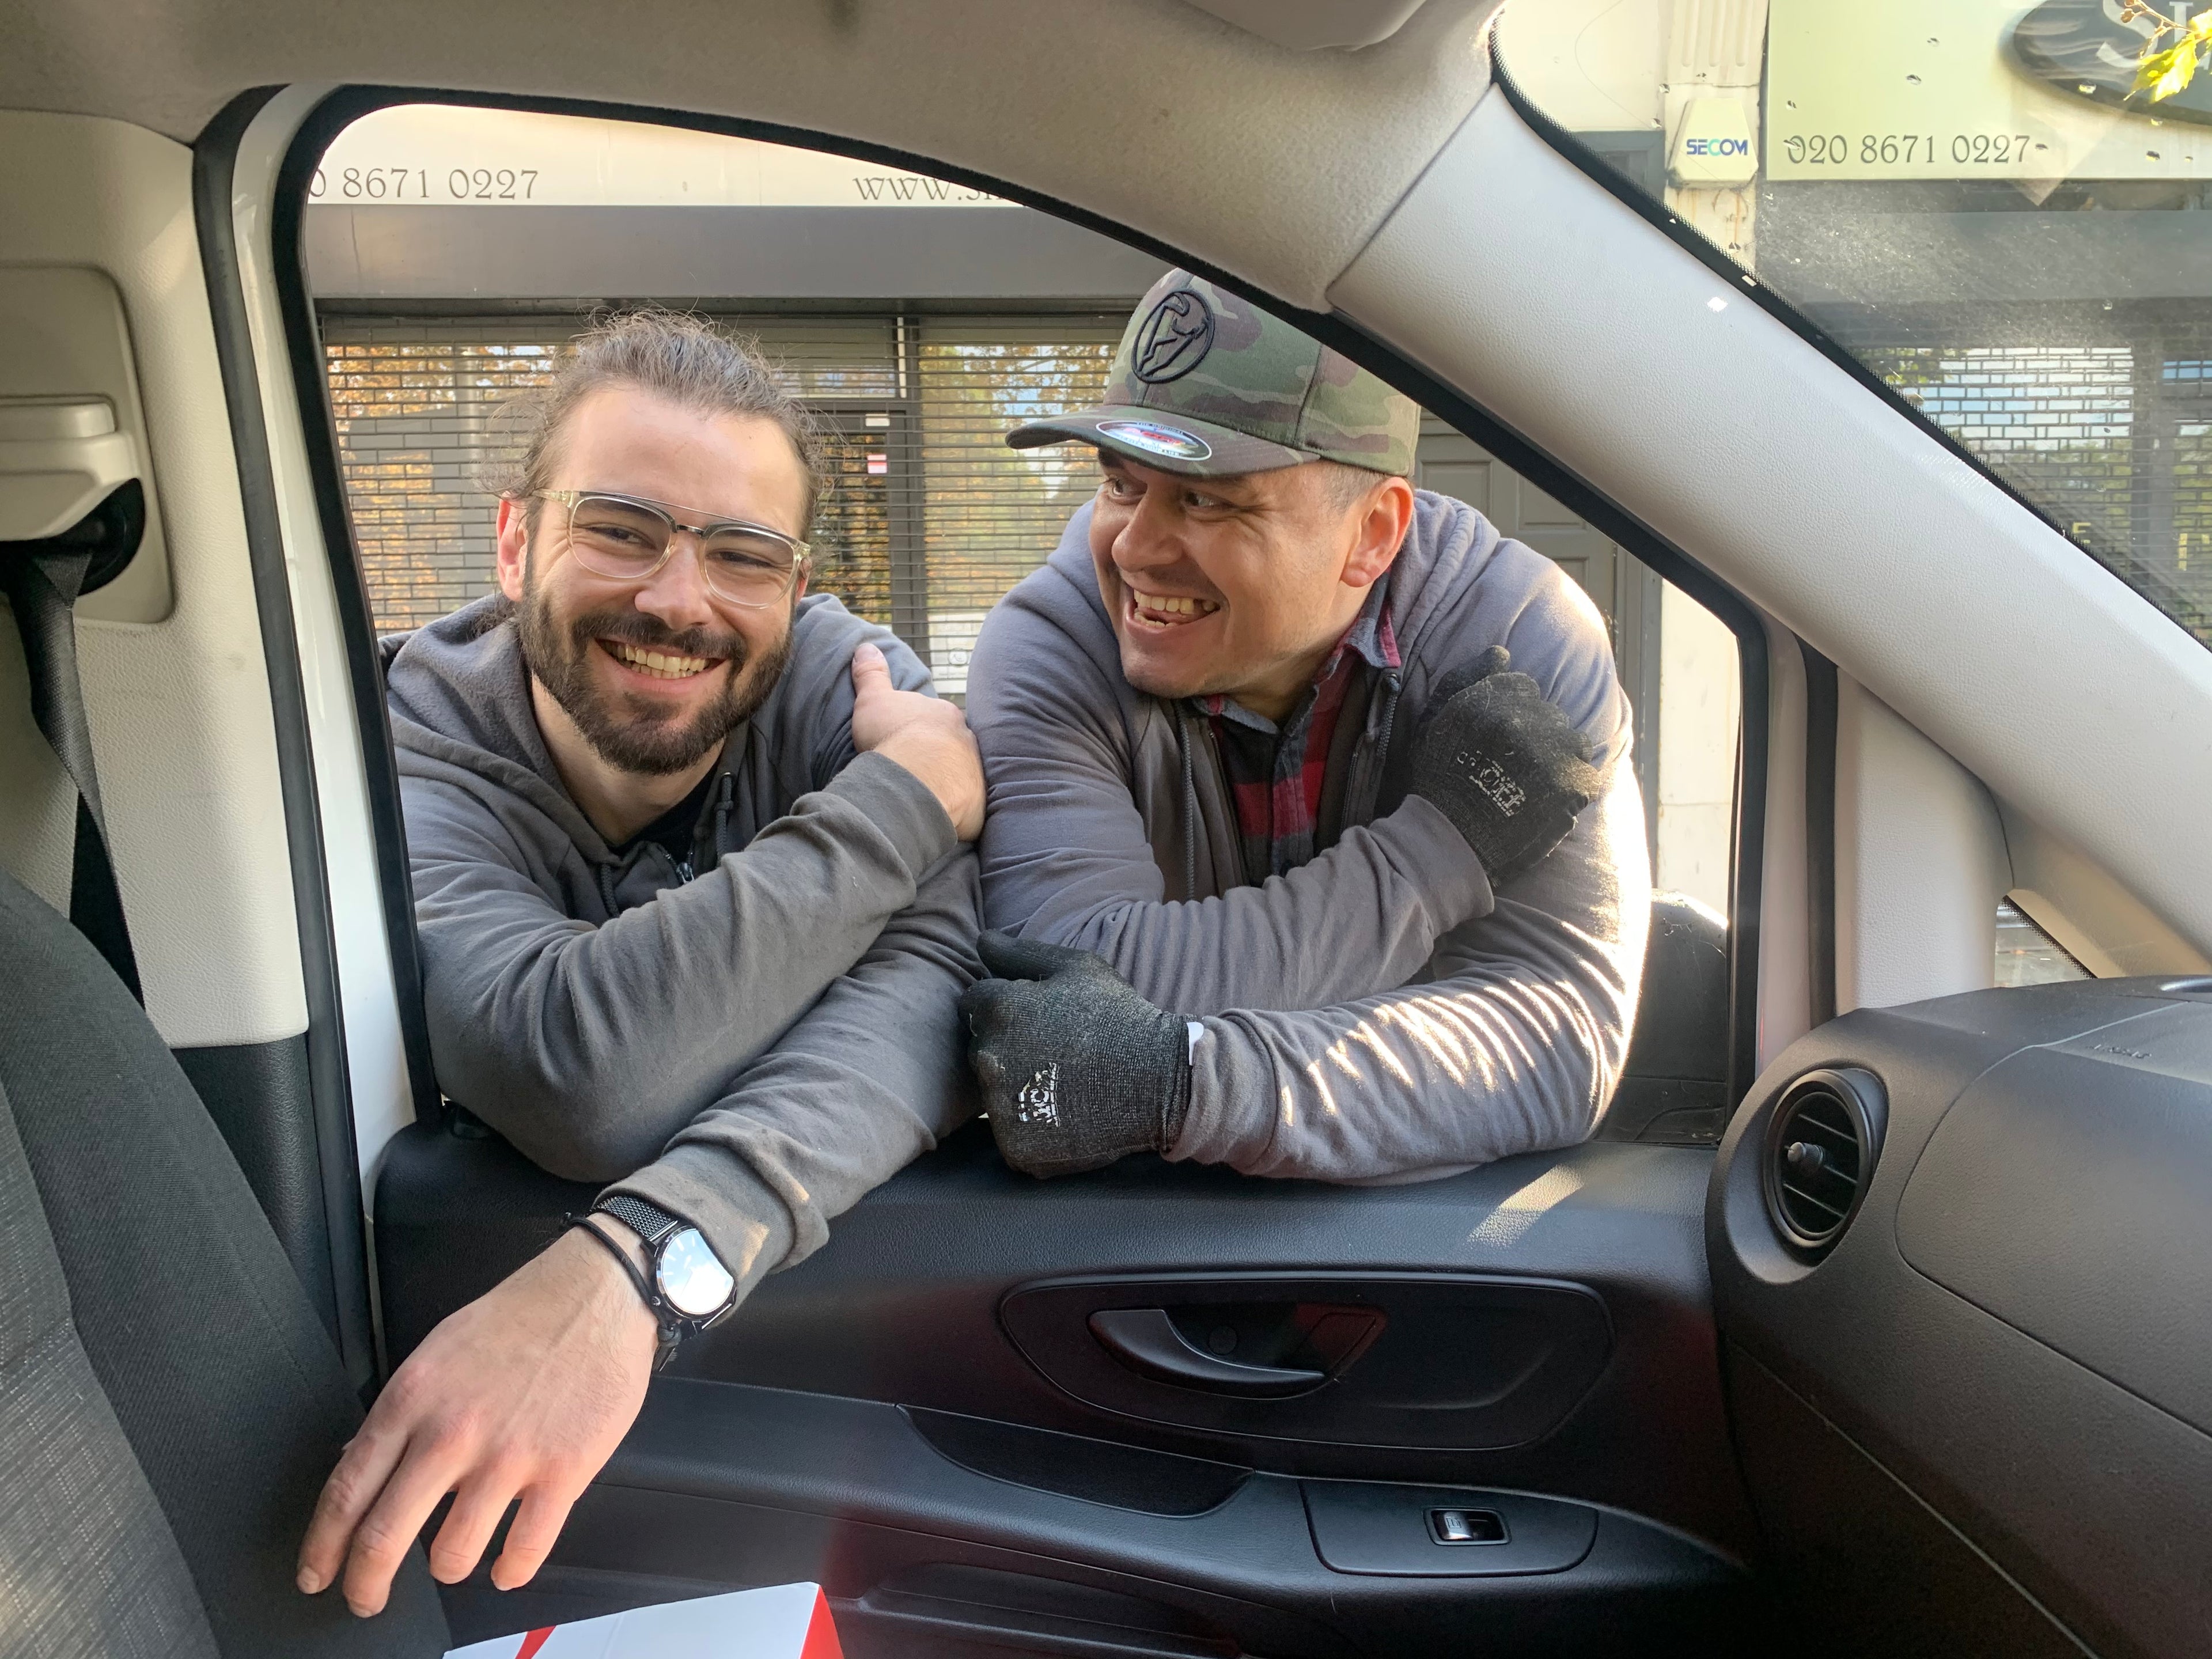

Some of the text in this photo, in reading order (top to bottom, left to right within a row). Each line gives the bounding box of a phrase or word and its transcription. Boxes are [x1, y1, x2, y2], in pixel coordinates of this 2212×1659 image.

[1686, 138, 1748, 156] SECOM
[1787, 134, 2031, 164] 020 8671 0227
[342, 168, 430, 198] 8671
[449, 169, 539, 199] 0227
